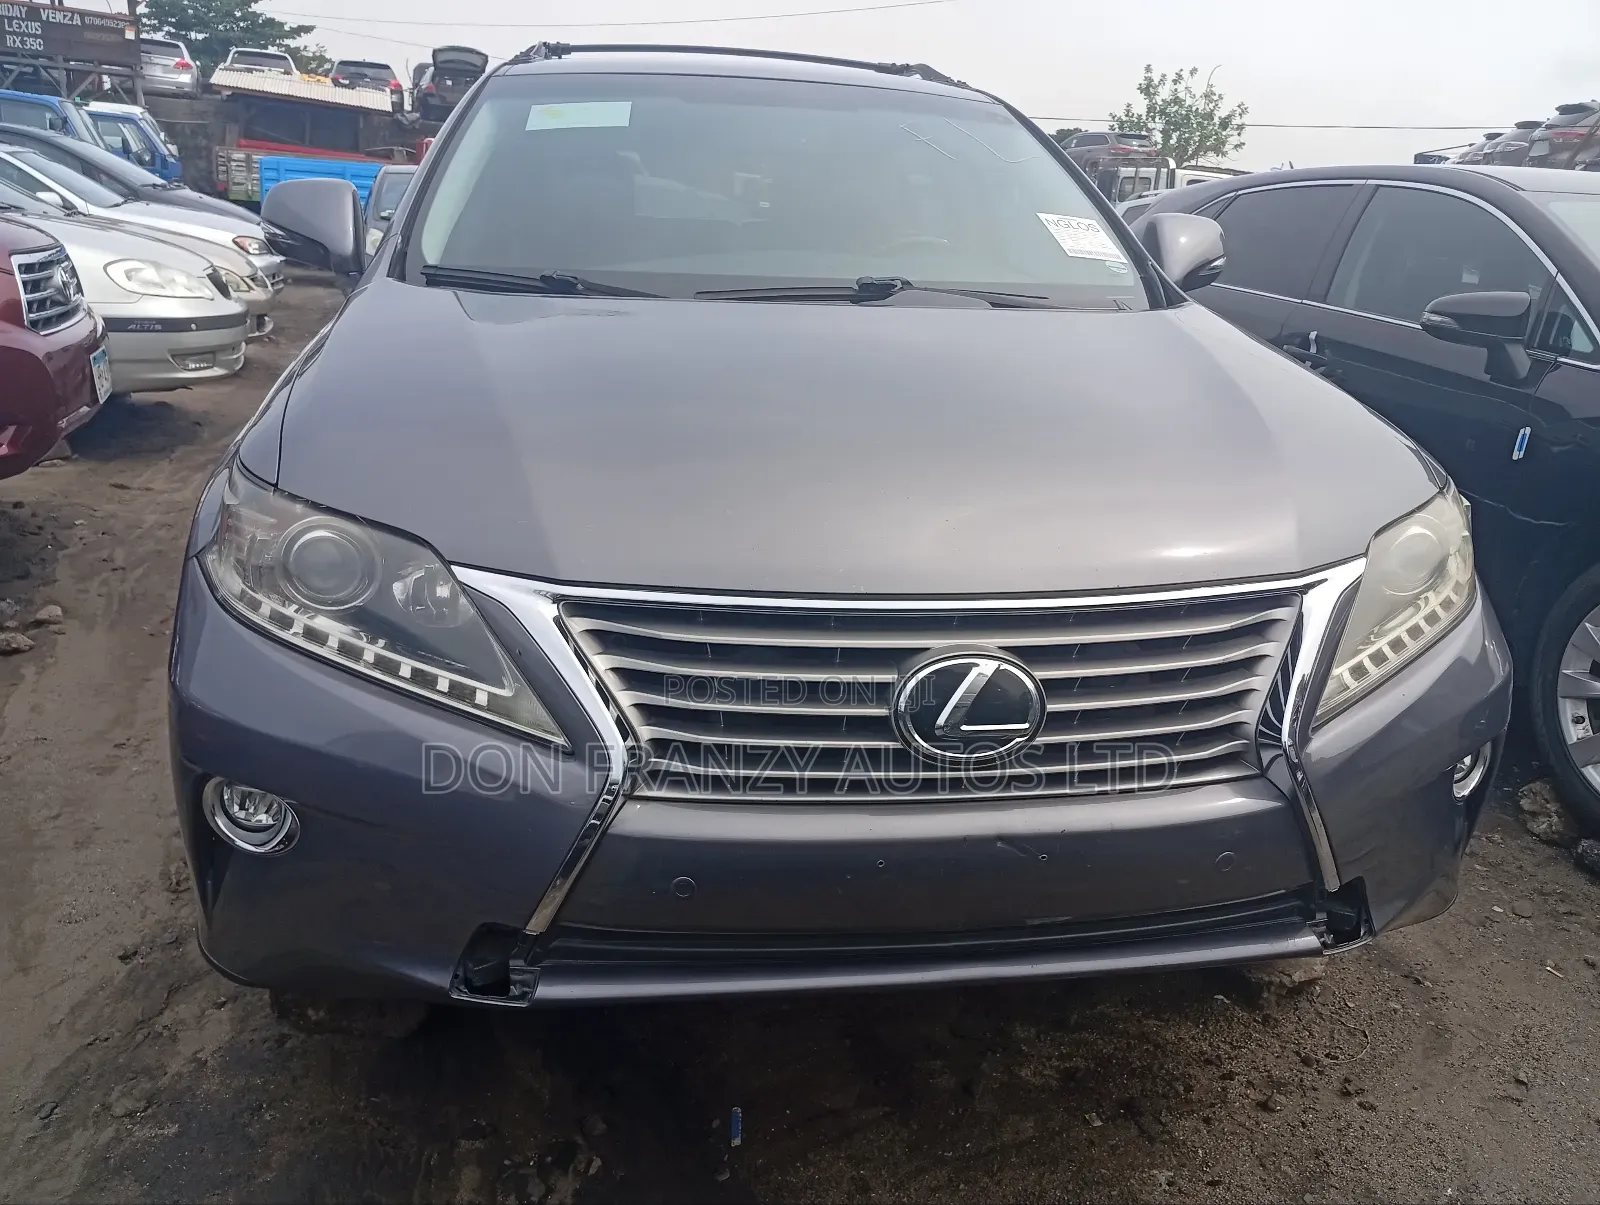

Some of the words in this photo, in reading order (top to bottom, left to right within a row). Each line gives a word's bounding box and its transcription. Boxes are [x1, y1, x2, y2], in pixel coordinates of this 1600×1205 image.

[40, 9, 82, 26] VENZA
[4, 18, 42, 35] LEXUS
[1045, 218, 1100, 232] NGLOS
